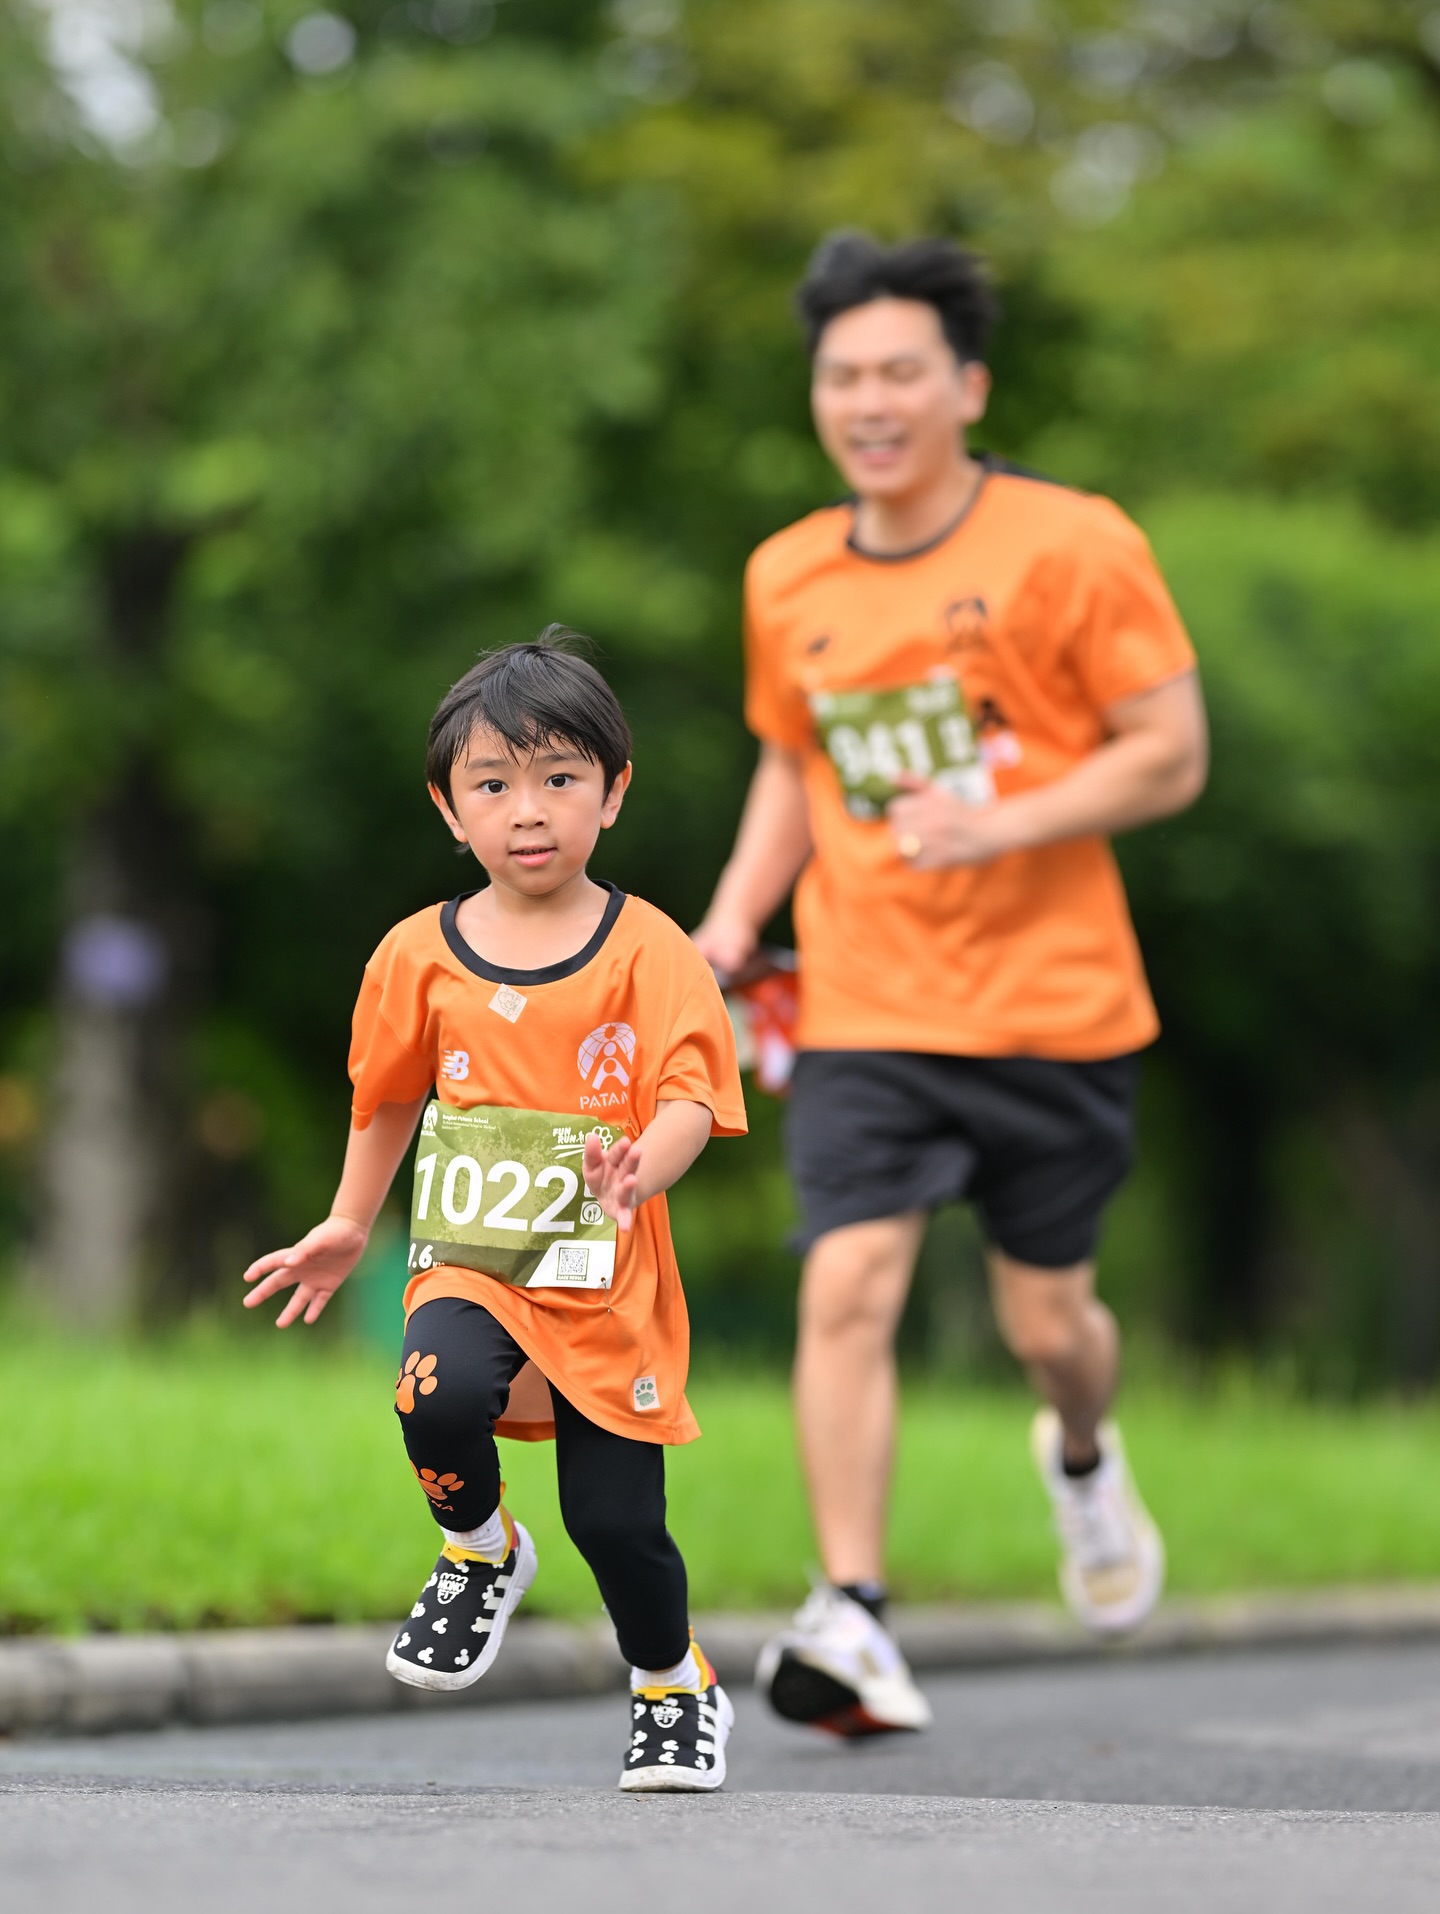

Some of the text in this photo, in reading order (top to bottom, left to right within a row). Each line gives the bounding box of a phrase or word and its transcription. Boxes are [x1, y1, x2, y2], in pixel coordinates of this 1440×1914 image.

[579, 1090, 629, 1111] PATAN
[552, 1126, 571, 1137] FUN
[557, 1134, 576, 1144] RUN
[416, 1152, 579, 1233] 1022
[407, 1242, 434, 1269] 1.6
